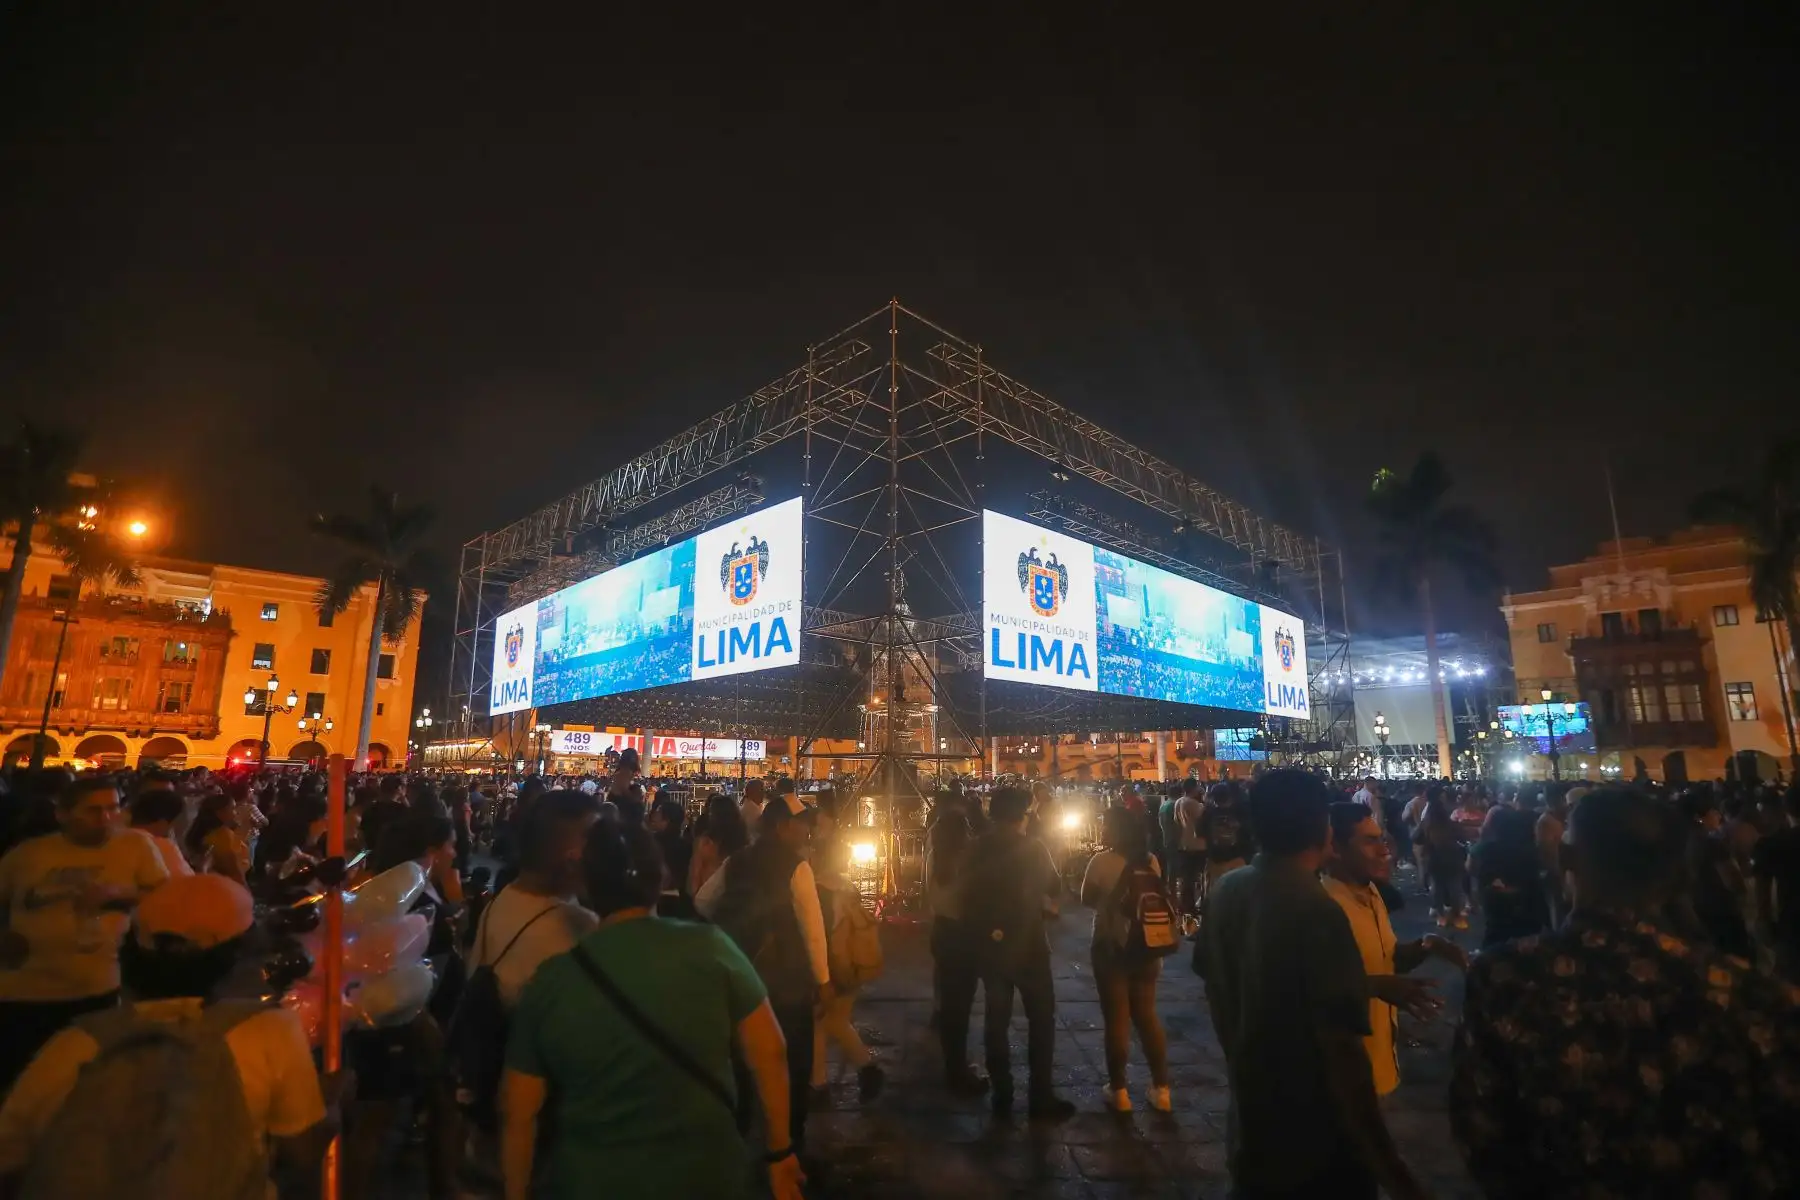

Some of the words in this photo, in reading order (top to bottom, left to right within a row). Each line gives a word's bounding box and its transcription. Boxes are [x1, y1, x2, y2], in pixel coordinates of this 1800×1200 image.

[699, 604, 775, 630] MUNICIPALIDAD
[778, 600, 793, 622] DE
[991, 613, 1075, 638] MUNICIPALIDAD
[1079, 630, 1089, 641] DE
[698, 616, 792, 668] LIMA
[991, 628, 1090, 679] LIMA
[492, 677, 528, 708] LIMA
[1268, 682, 1307, 711] LIMA
[563, 732, 591, 744] 489
[680, 741, 718, 754] Querda
